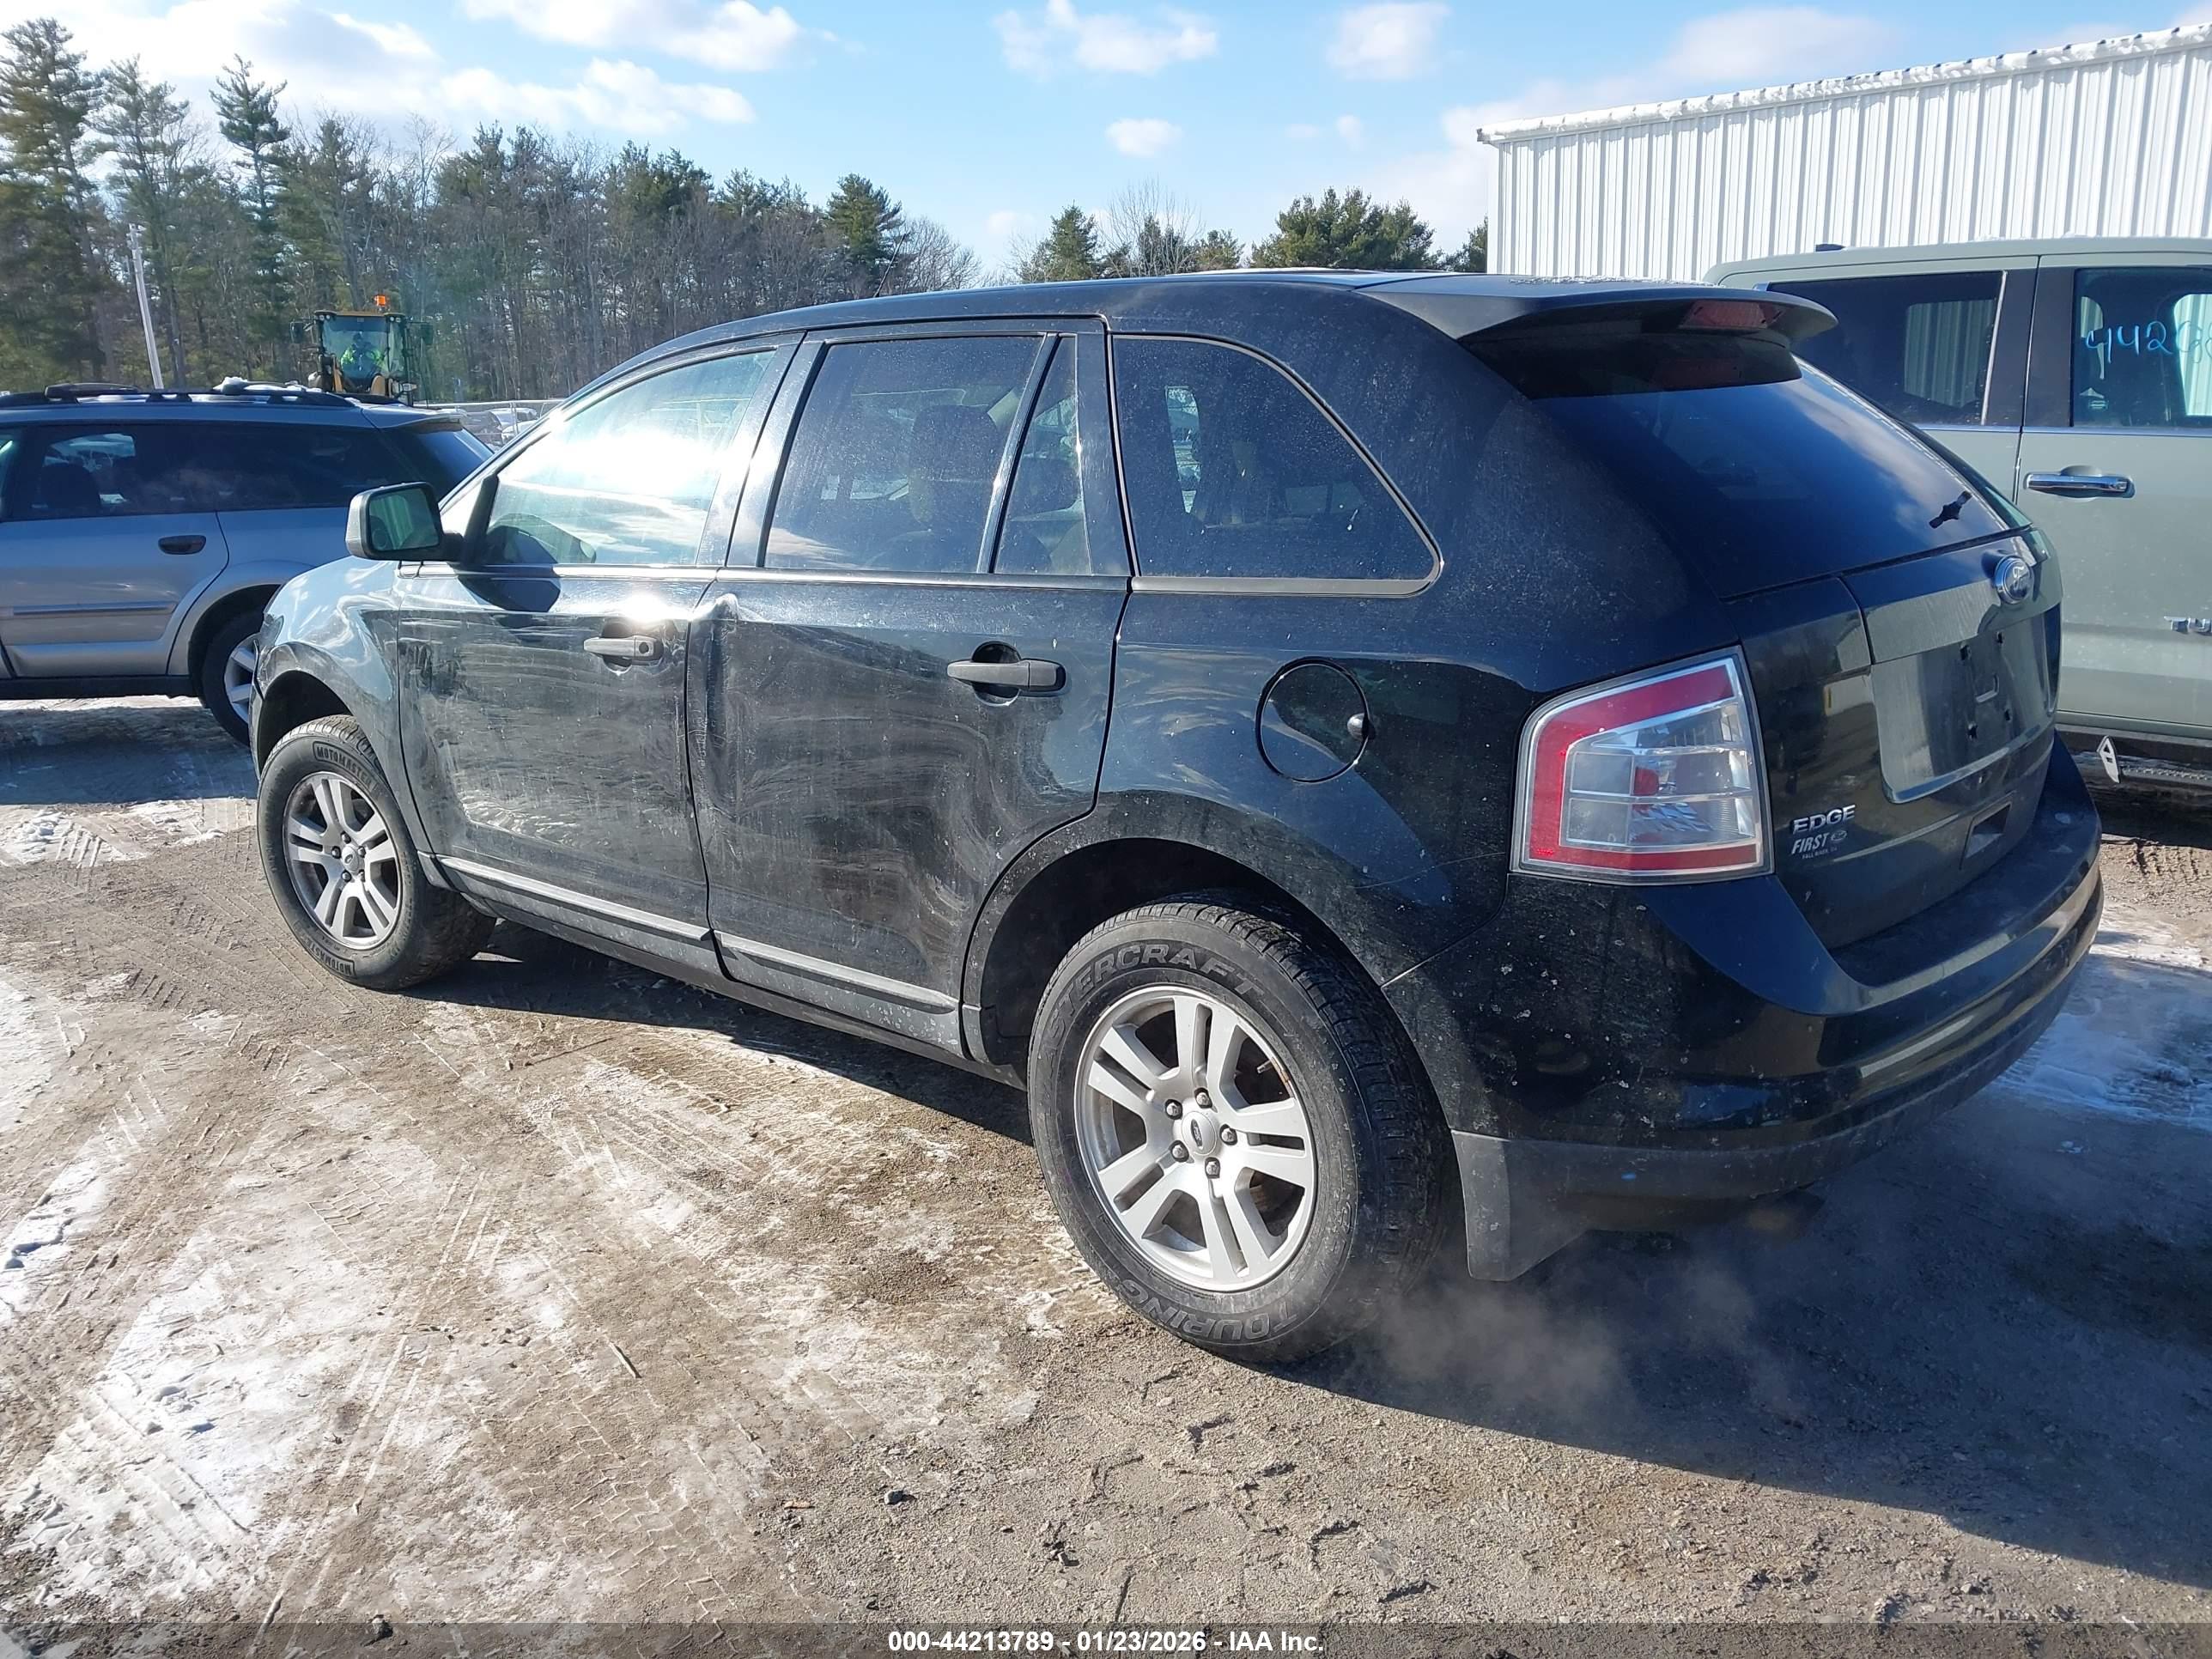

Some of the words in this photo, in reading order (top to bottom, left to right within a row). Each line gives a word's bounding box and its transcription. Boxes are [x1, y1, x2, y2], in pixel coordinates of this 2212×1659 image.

[1792, 804, 1856, 835] EDGE
[1791, 832, 1830, 855] FIRST
[1117, 1279, 1297, 1340] TOURING
